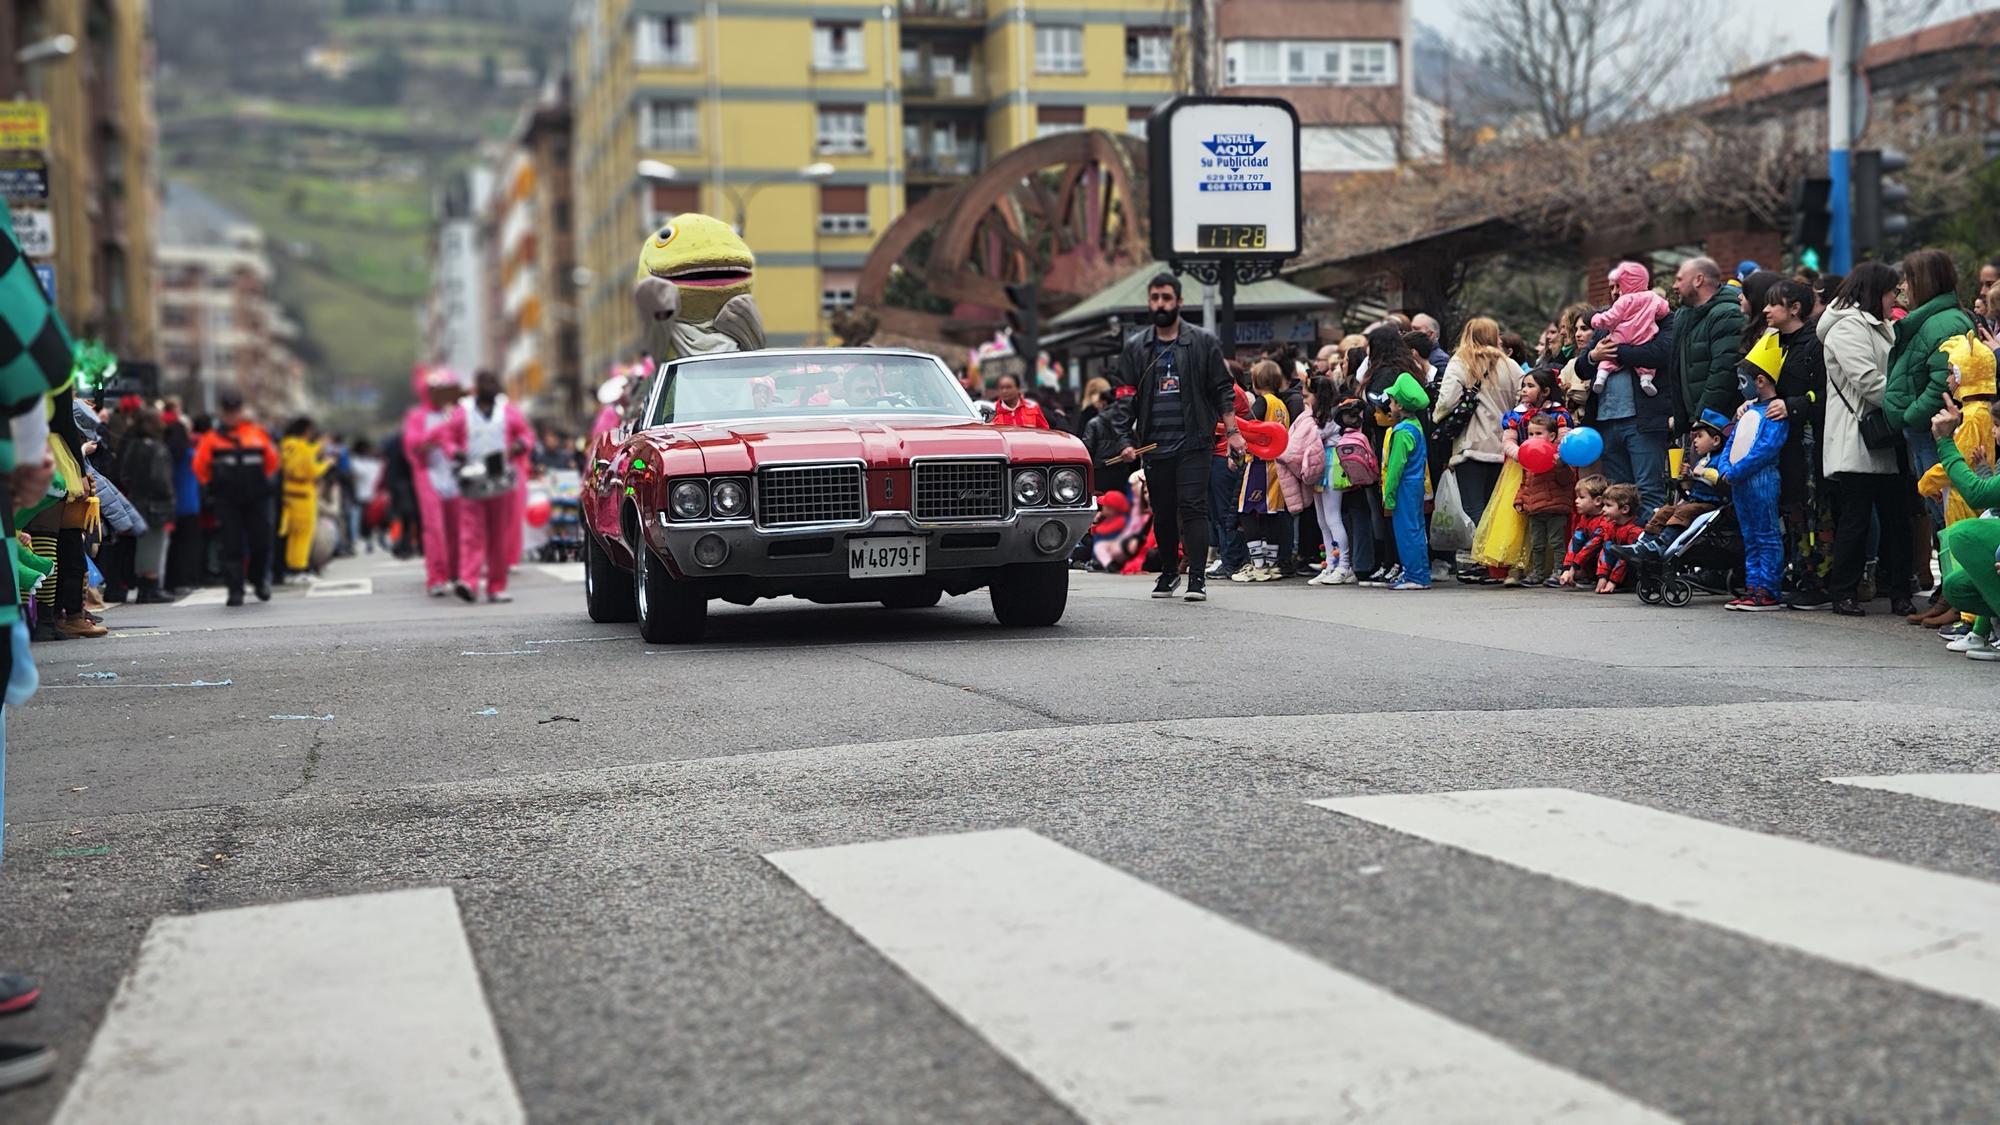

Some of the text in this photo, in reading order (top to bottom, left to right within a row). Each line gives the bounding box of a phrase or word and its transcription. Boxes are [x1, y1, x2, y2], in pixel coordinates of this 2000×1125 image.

[1216, 135, 1252, 144] INSTALE
[1215, 145, 1255, 155] AQUI
[1201, 156, 1269, 167] Su Publicidad
